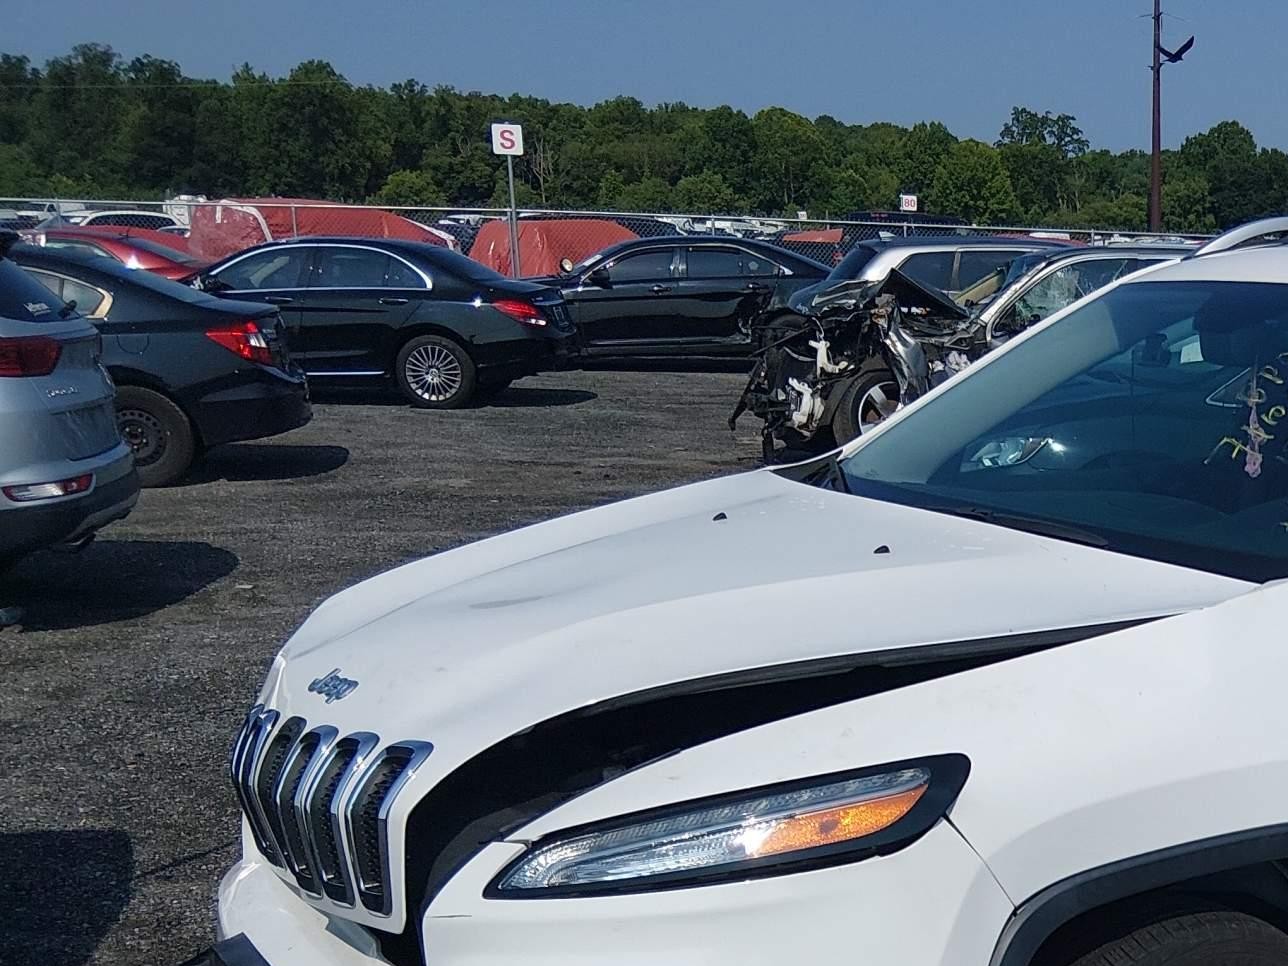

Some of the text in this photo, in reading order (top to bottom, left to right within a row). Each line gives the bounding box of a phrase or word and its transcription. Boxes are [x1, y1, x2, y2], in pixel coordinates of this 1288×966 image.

[499, 129, 516, 150] S
[904, 198, 916, 208] 80
[308, 668, 360, 704] Jeep
